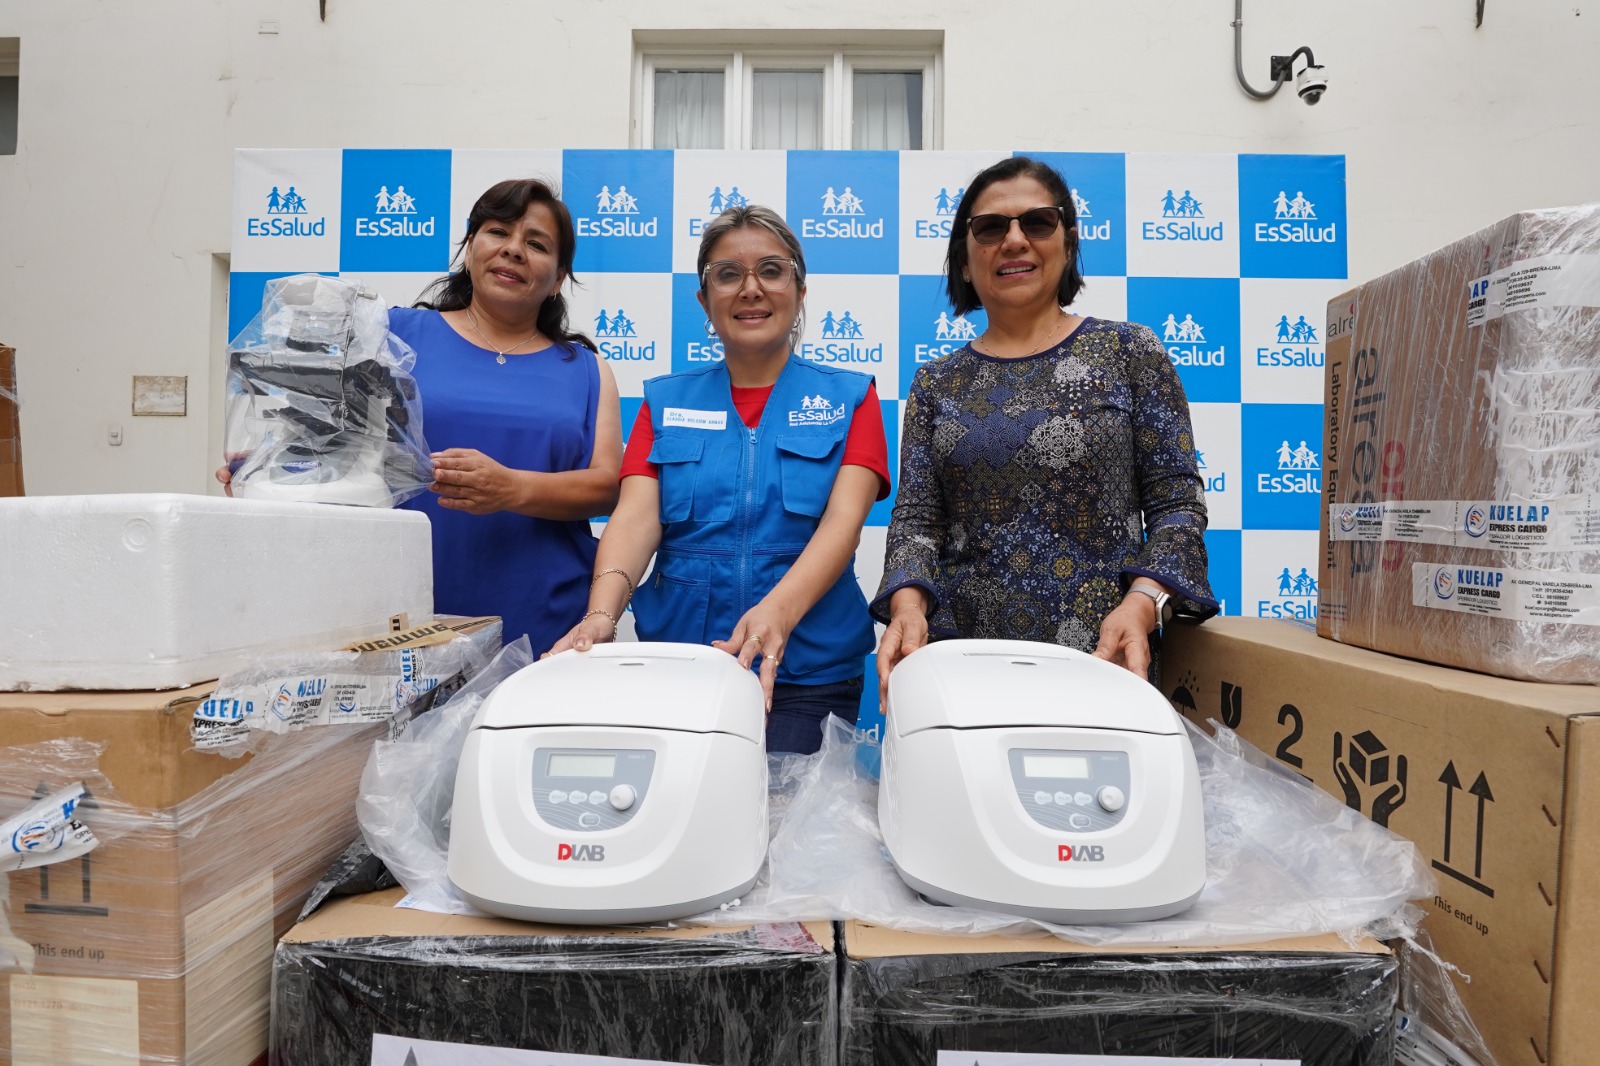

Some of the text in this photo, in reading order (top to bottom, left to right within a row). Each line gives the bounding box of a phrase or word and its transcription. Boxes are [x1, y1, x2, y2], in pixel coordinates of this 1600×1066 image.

[248, 217, 325, 237] EsSalud
[355, 216, 435, 238] EsSalud
[576, 216, 658, 238] EsSalud
[802, 218, 884, 239] EsSalud
[1142, 221, 1224, 241] EsSalud
[1255, 222, 1336, 243] EsSalud
[599, 341, 655, 361] Salud
[802, 343, 882, 363] EsSalud
[1171, 346, 1225, 367] Salud
[1257, 348, 1324, 368] EsSalu
[789, 403, 845, 422] EsSalud
[1328, 361, 1342, 463] Laboratory
[1258, 473, 1321, 493] EsSalu
[1489, 505, 1550, 522] KUELAP
[1489, 524, 1548, 533] EXPRESS CARGO
[1458, 569, 1503, 588] KUELAP
[1458, 587, 1501, 599] EXPRESS CARGO
[1258, 600, 1318, 619] EsSal
[402, 649, 412, 682] KUEL
[1275, 703, 1304, 770] 2
[557, 843, 605, 862] DLAB
[1058, 845, 1105, 862] DLAB
[1434, 896, 1489, 936] This end up
[31, 944, 105, 962] This end up
